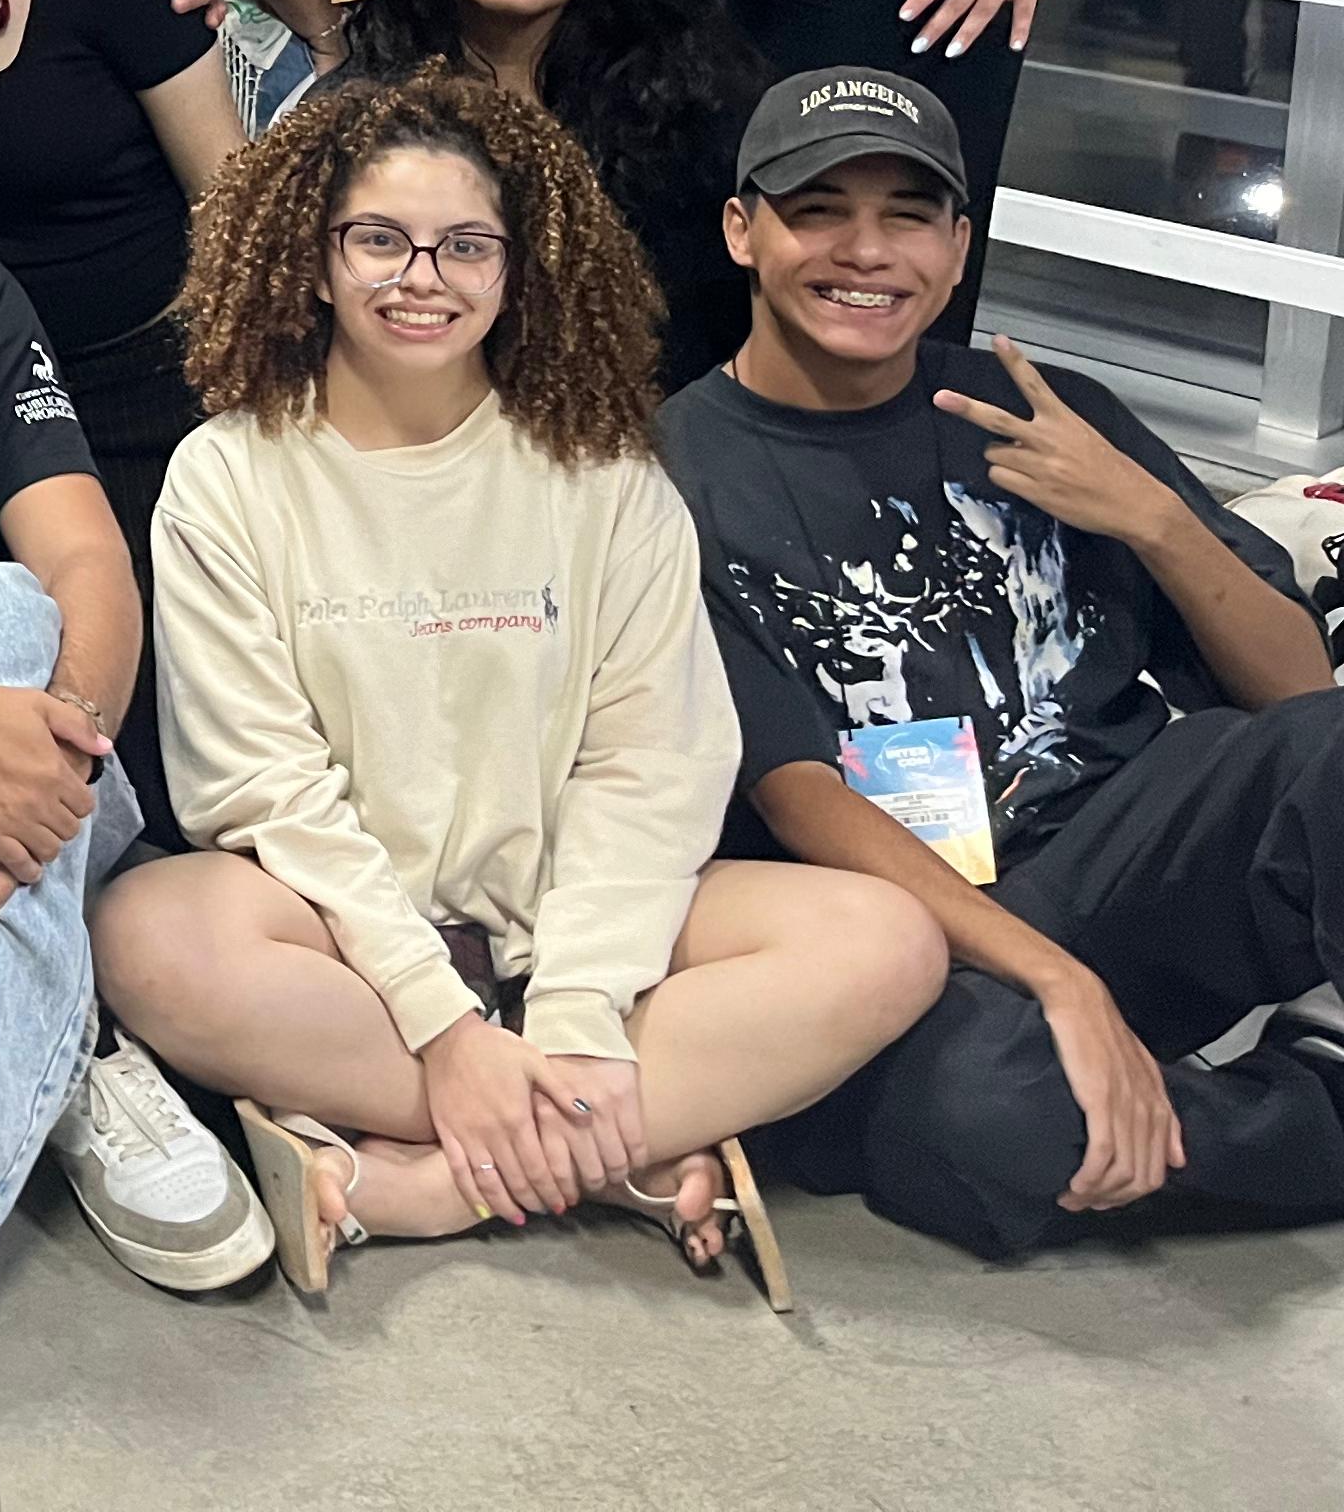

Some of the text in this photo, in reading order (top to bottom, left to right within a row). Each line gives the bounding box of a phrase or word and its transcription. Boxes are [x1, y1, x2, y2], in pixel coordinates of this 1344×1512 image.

[800, 80, 919, 124] LOS ANGELES
[458, 614, 542, 633] company
